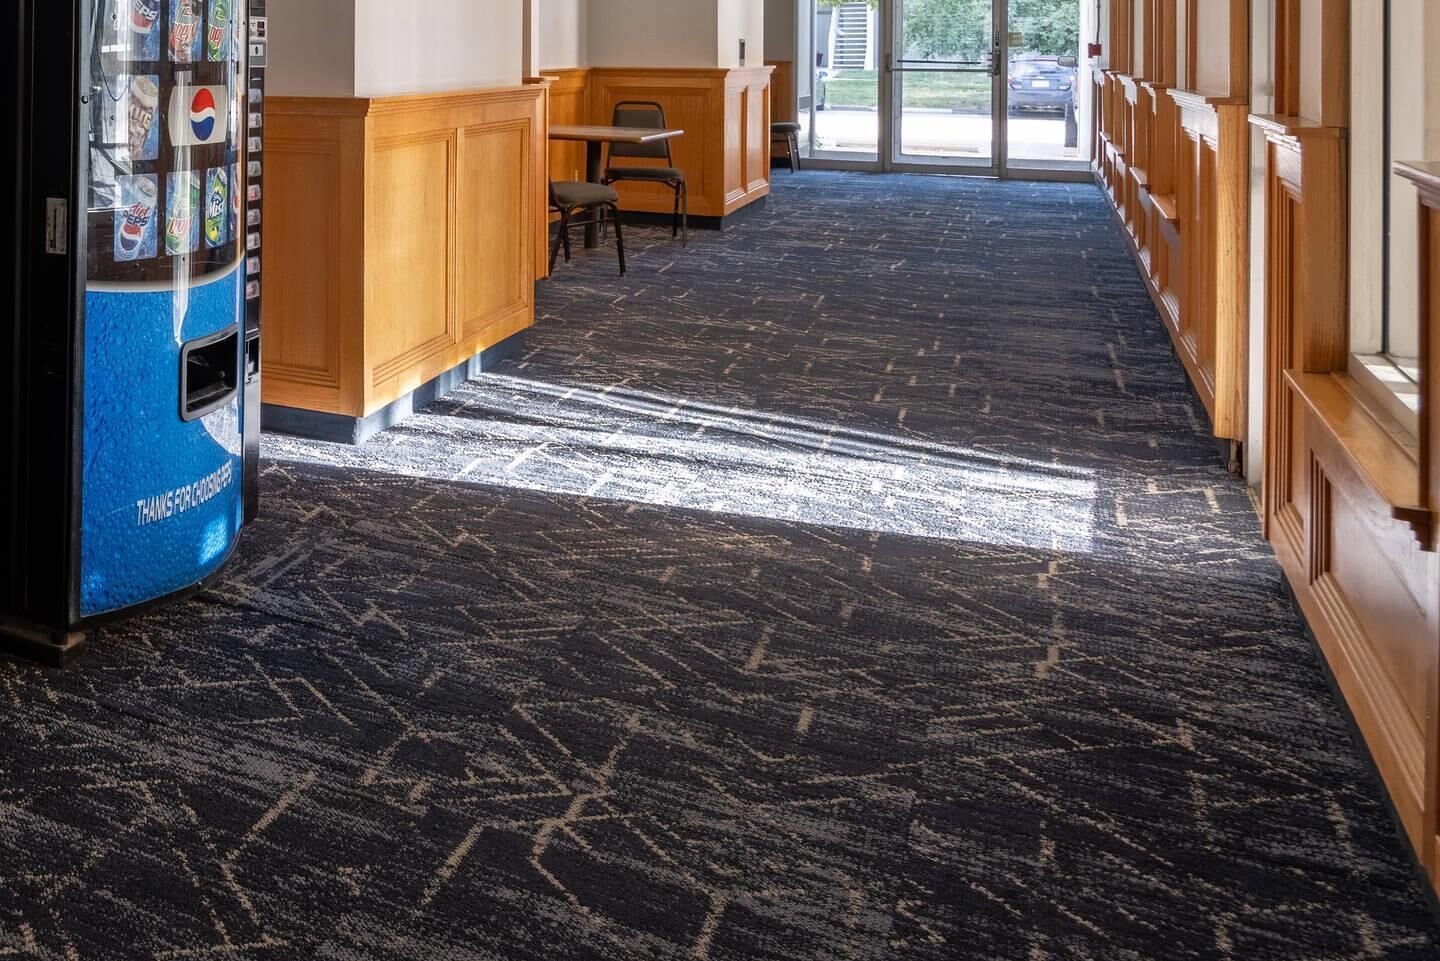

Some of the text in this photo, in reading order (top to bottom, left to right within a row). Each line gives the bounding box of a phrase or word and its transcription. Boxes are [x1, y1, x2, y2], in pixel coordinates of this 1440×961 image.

[122, 209, 151, 226] PEPS
[137, 490, 173, 526] THANKS
[174, 484, 191, 515] FOR
[191, 467, 221, 508] CHOOSING
